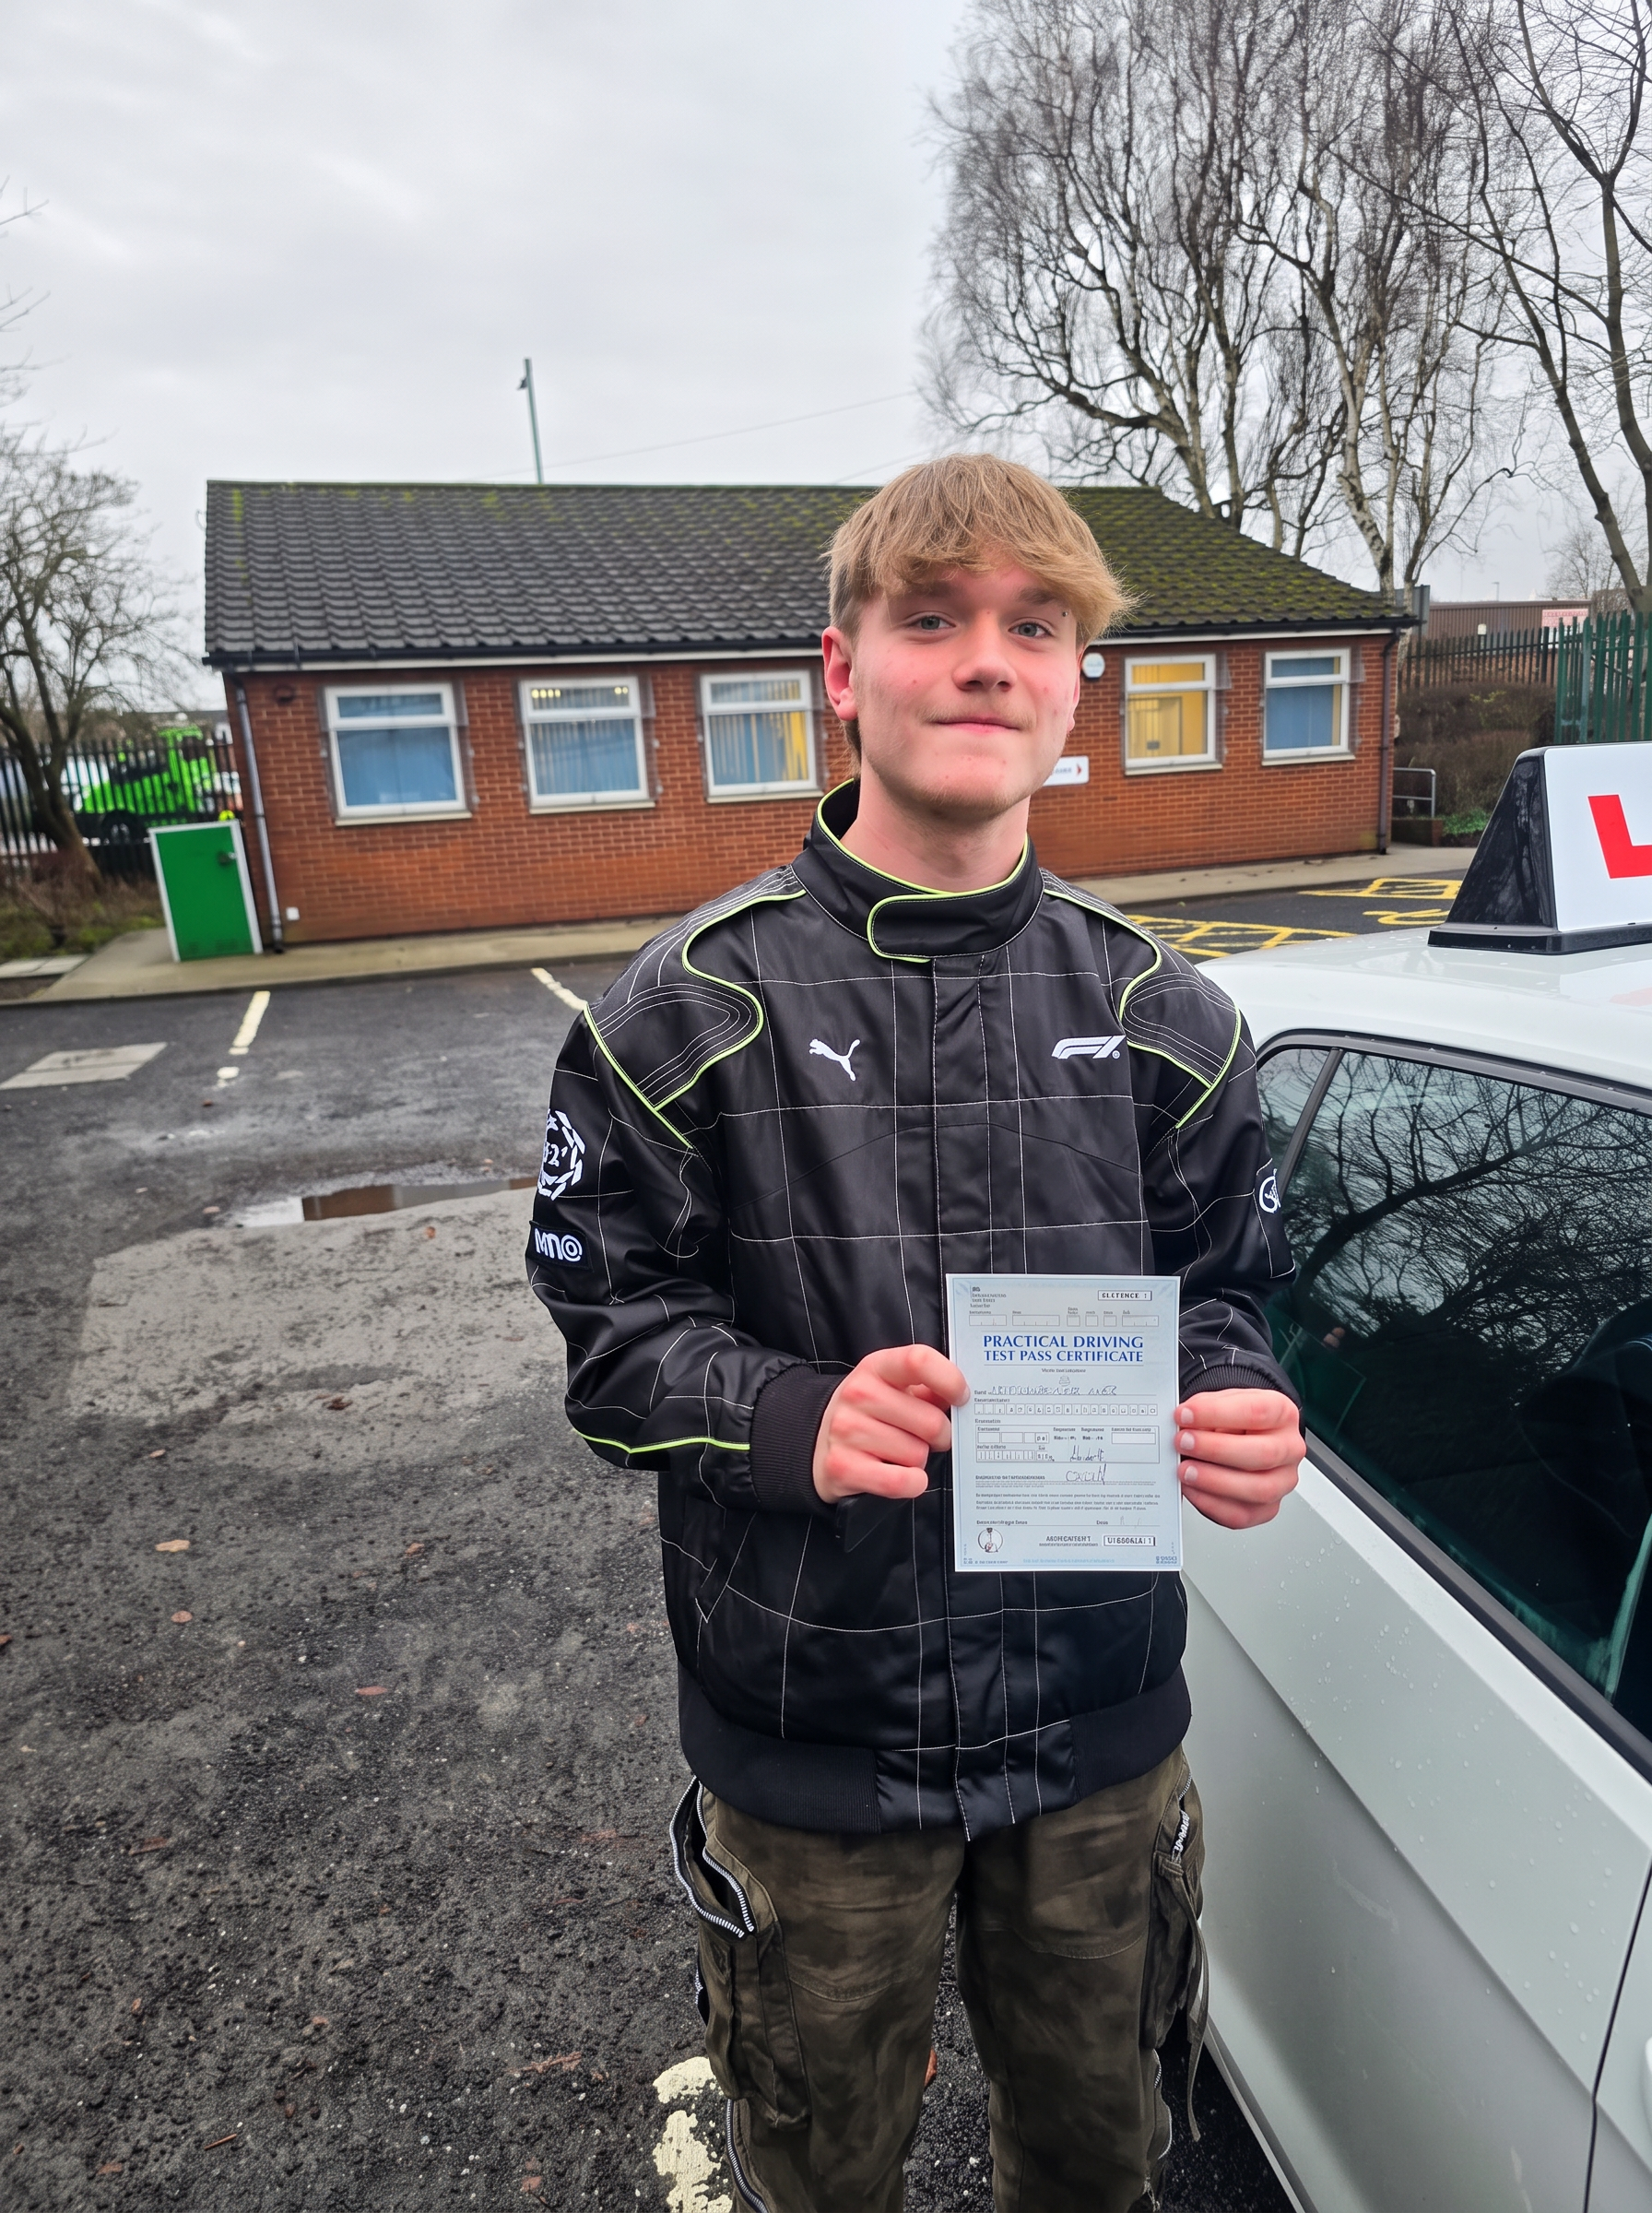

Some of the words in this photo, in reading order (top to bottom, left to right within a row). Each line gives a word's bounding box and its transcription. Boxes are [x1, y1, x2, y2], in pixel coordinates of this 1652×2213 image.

[1587, 794, 1652, 879] L
[983, 1335, 1068, 1348] PRACTICAL
[1073, 1336, 1144, 1349] DRIVING
[984, 1350, 1016, 1362] TEST
[1020, 1350, 1052, 1362] PASS
[1056, 1351, 1144, 1363] CERTIFICATE
